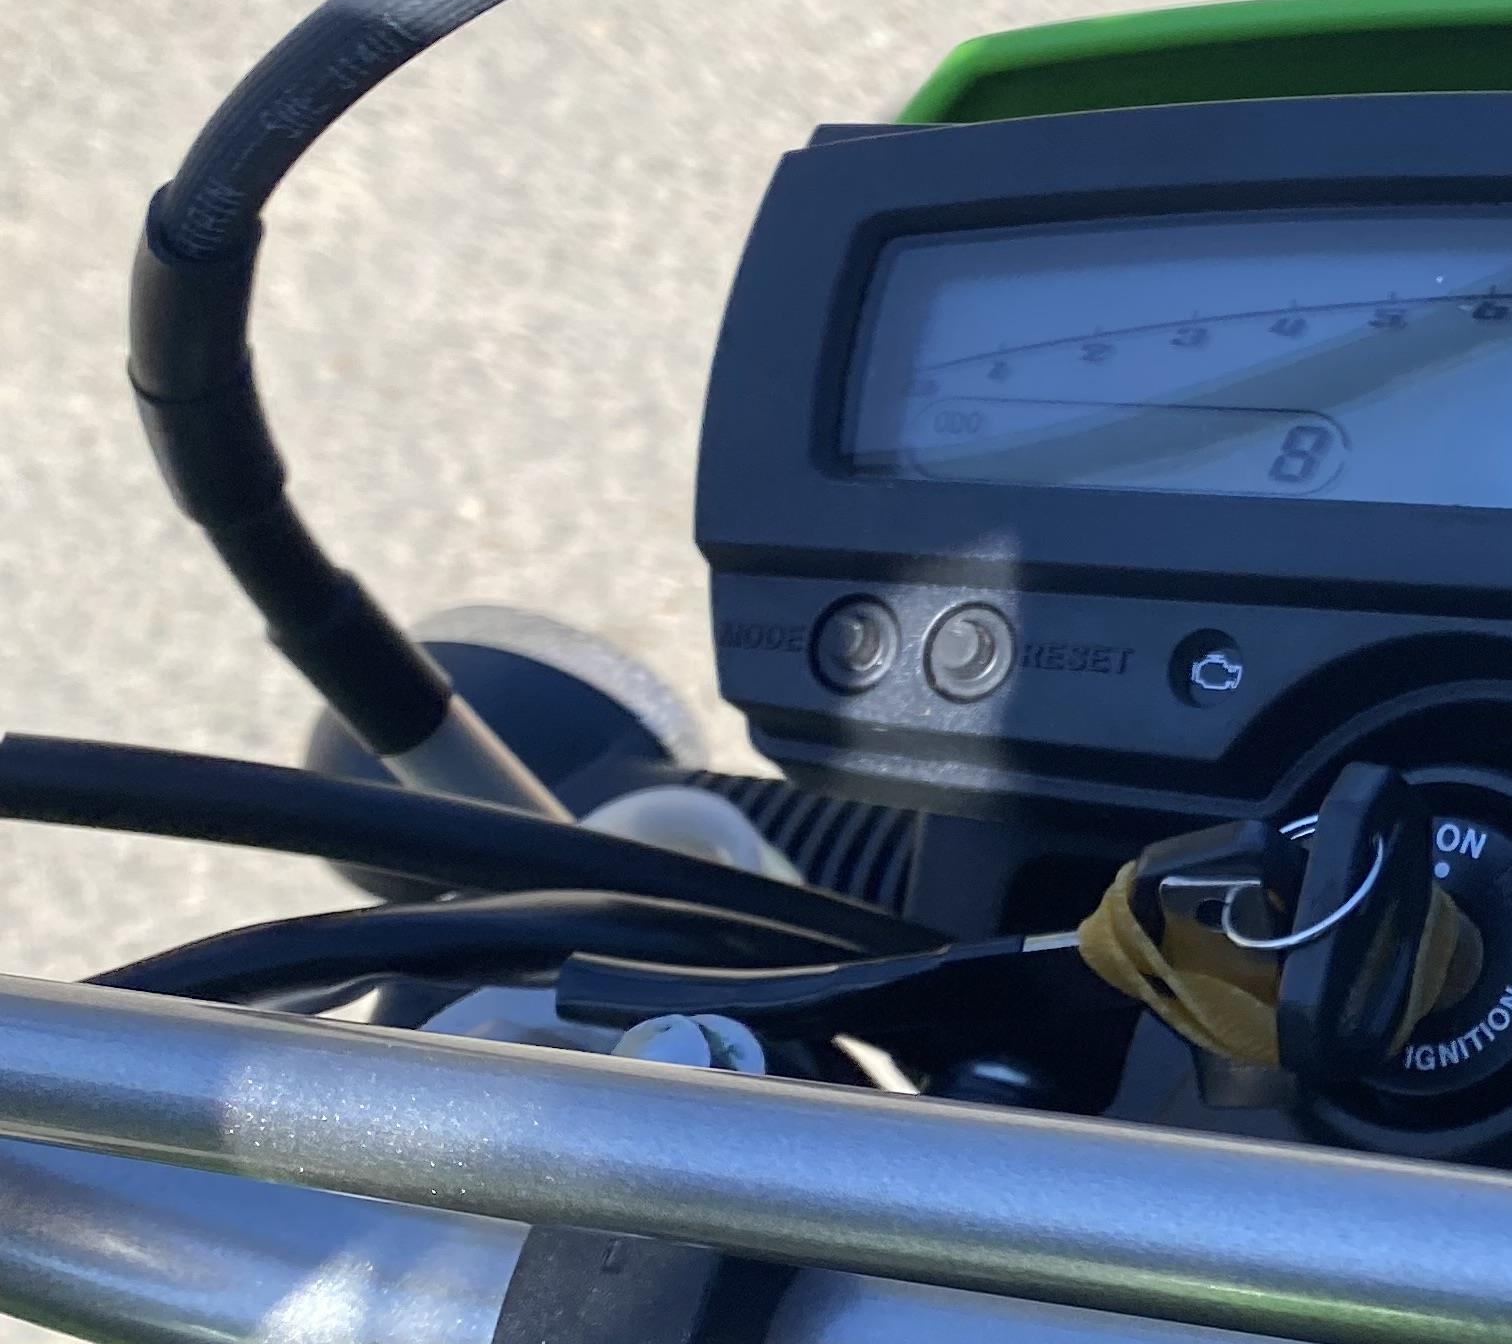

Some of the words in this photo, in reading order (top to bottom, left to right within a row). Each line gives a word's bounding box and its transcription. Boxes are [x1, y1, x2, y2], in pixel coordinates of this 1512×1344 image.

[1269, 425, 1333, 483] 8
[1021, 643, 1136, 674] RESET
[1436, 823, 1487, 859] ON
